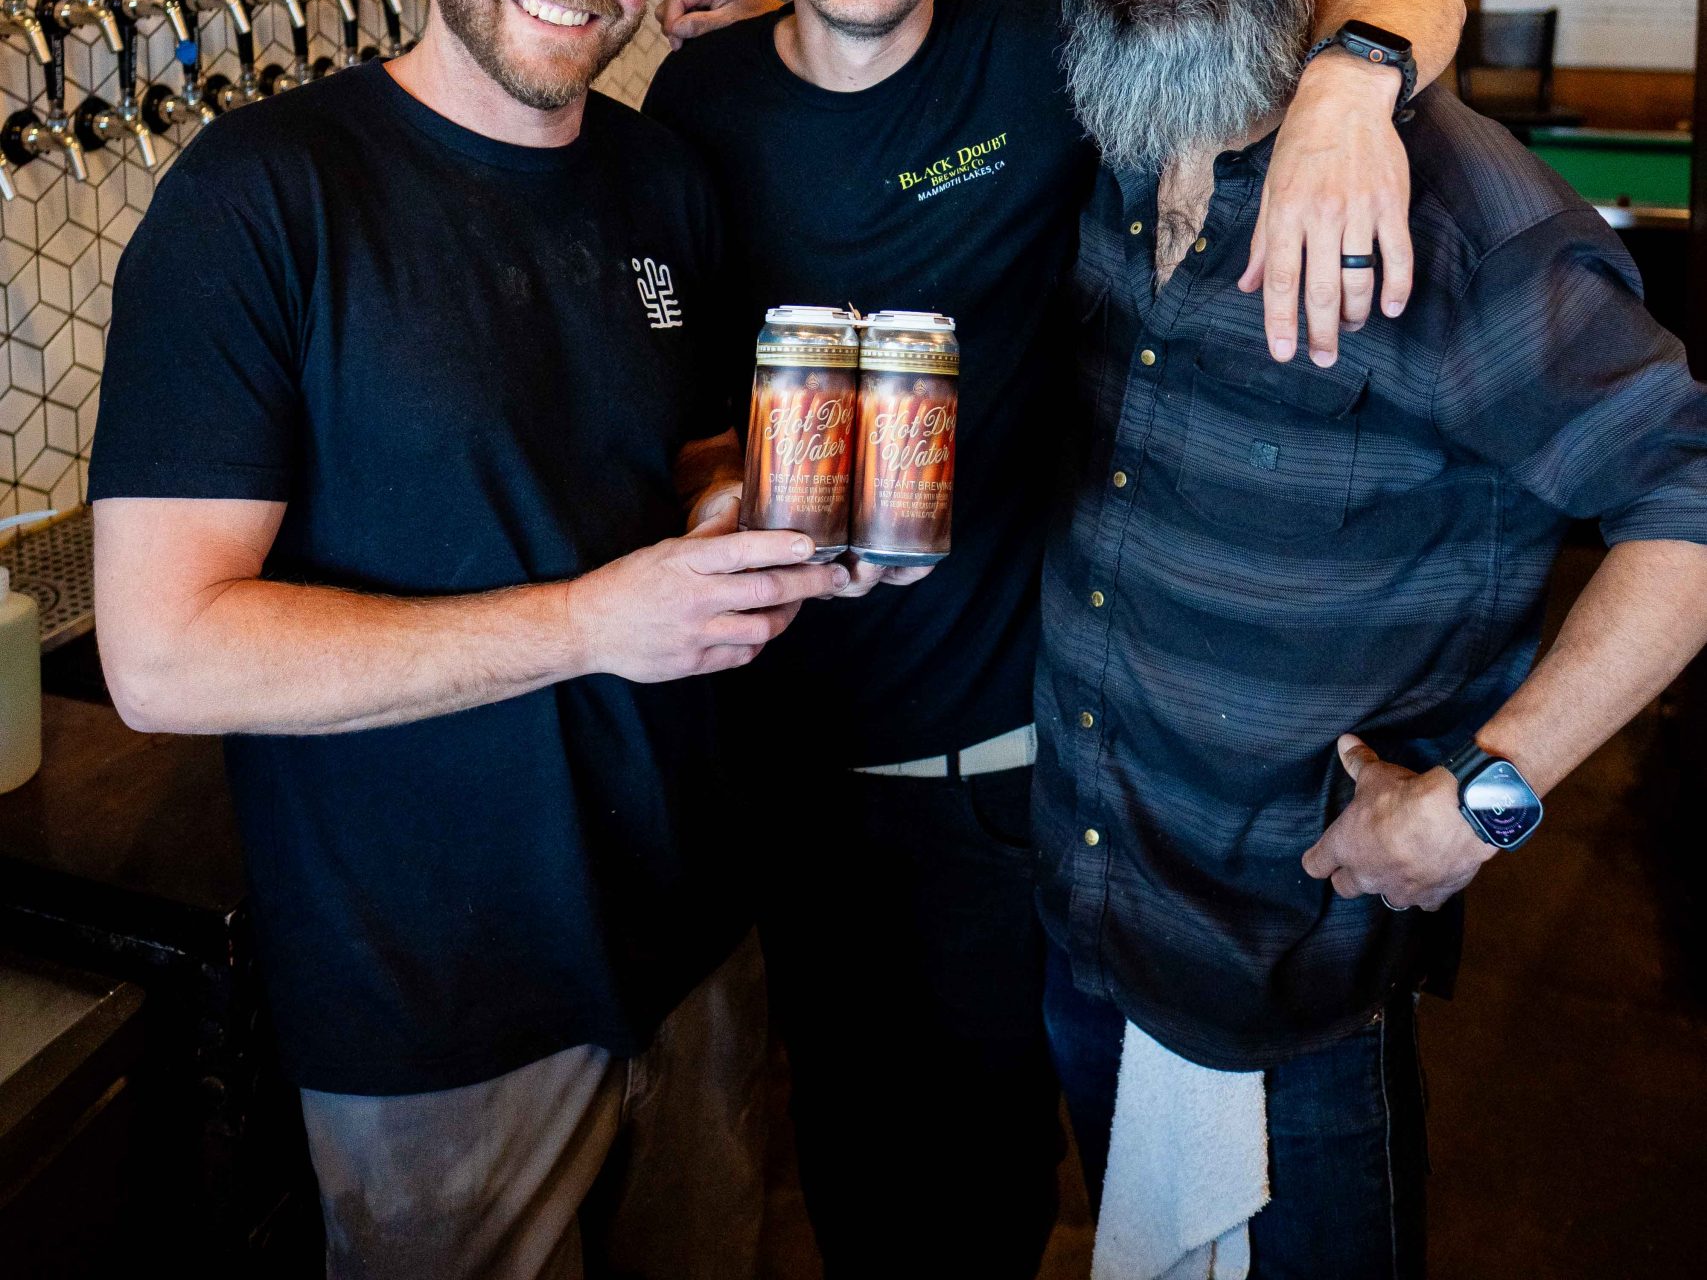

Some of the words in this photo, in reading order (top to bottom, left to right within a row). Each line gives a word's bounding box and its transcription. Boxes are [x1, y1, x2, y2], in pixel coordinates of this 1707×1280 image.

[898, 157, 952, 191] BLACK
[957, 133, 1007, 166] DOUBT
[931, 165, 970, 187] BREWING
[917, 177, 961, 201] MAMMOTH
[963, 165, 995, 182] LAKES,
[994, 160, 1006, 170] CA
[764, 406, 815, 440] Hot
[869, 412, 920, 445] Hot
[776, 433, 846, 466] Water
[881, 439, 949, 471] Water
[770, 472, 810, 484] DISTANT
[874, 478, 915, 489] DISTANT
